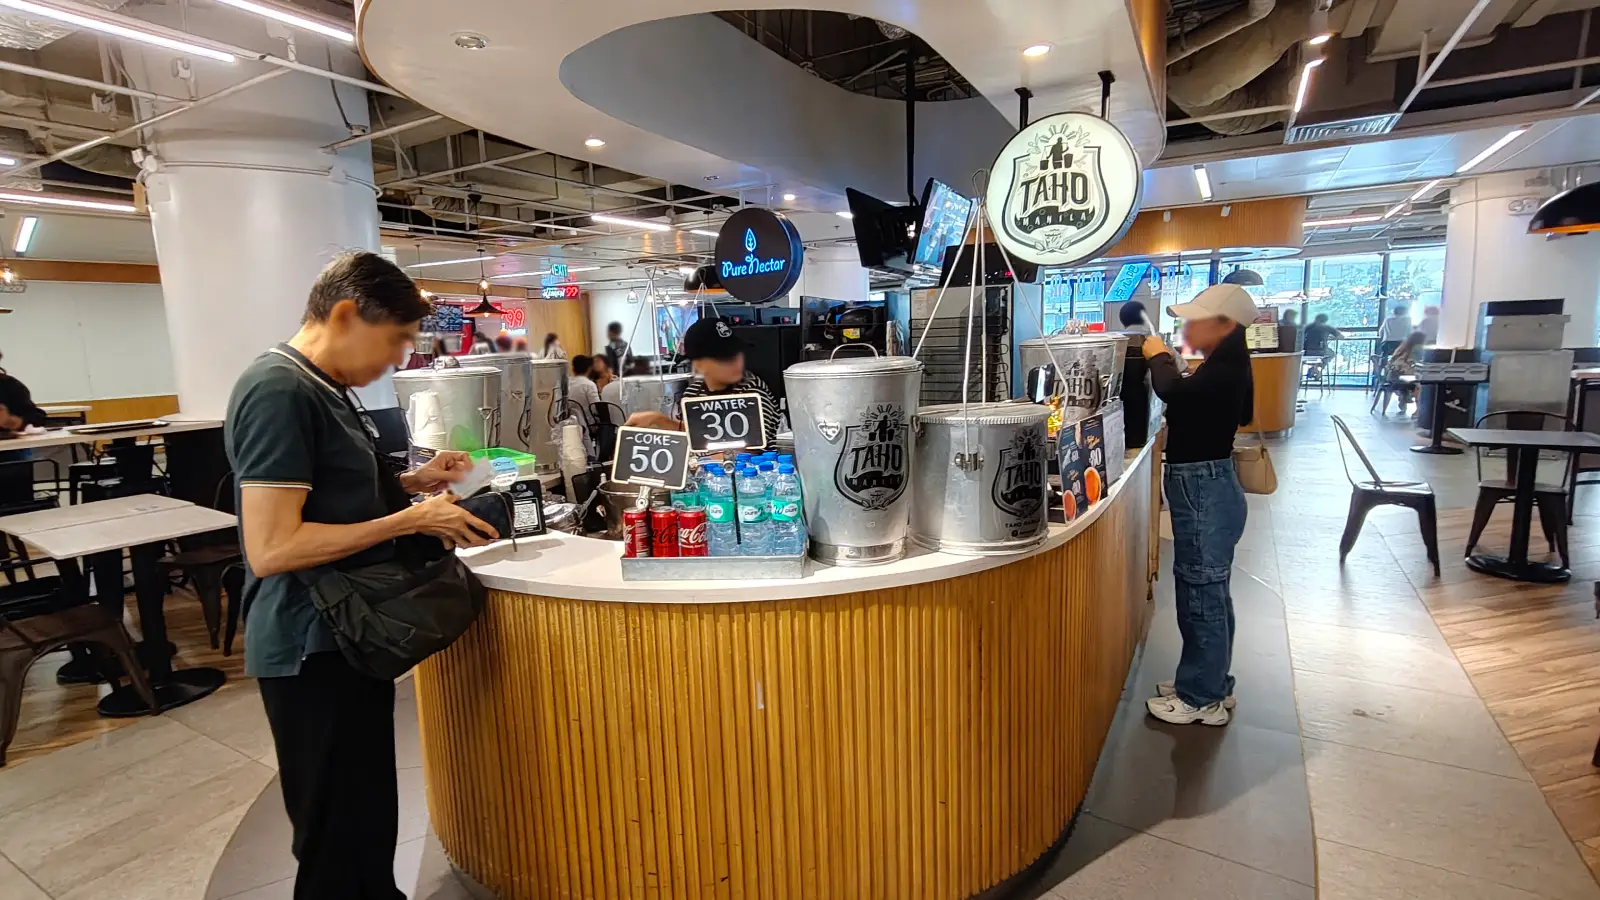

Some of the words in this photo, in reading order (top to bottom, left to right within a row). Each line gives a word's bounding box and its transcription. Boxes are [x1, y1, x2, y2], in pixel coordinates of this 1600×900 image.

[1020, 171, 1089, 215] TAHO
[1022, 211, 1087, 227] MANILA
[554, 263, 568, 277] EXIT
[721, 260, 748, 278] Pure
[745, 253, 786, 275] Nectar
[699, 398, 748, 412] WATER
[634, 433, 671, 446] COKE
[700, 411, 749, 441] 30
[629, 445, 674, 474] 50
[851, 443, 903, 476] TAHO
[1004, 461, 1042, 491] TAHO
